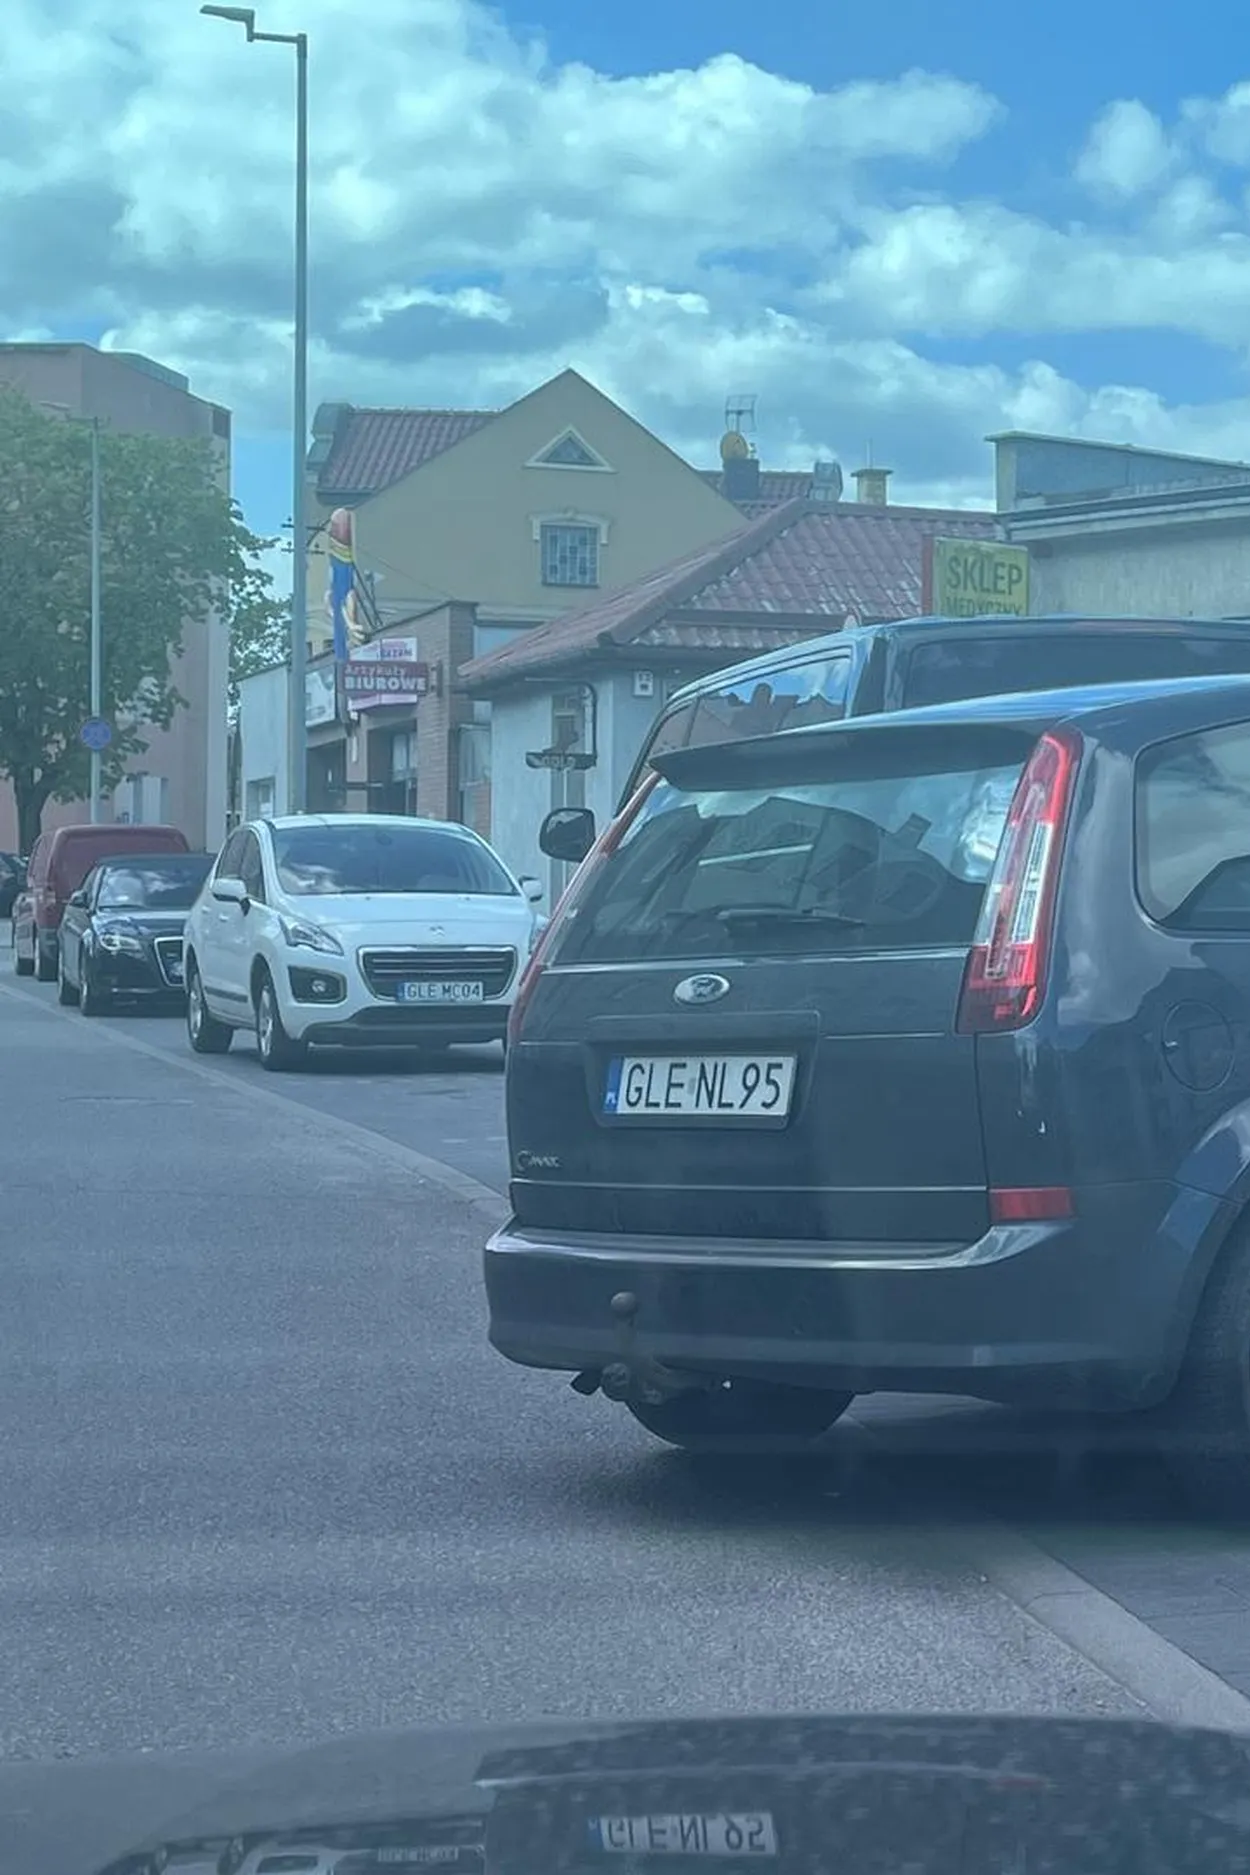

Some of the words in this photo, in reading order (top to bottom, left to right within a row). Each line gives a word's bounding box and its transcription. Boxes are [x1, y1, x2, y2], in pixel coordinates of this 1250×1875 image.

[946, 555, 1024, 596] SKLEP
[344, 676, 426, 691] BIUROWE
[407, 983, 437, 998] GLE
[625, 1062, 687, 1108] GLE
[695, 1061, 783, 1109] NL95
